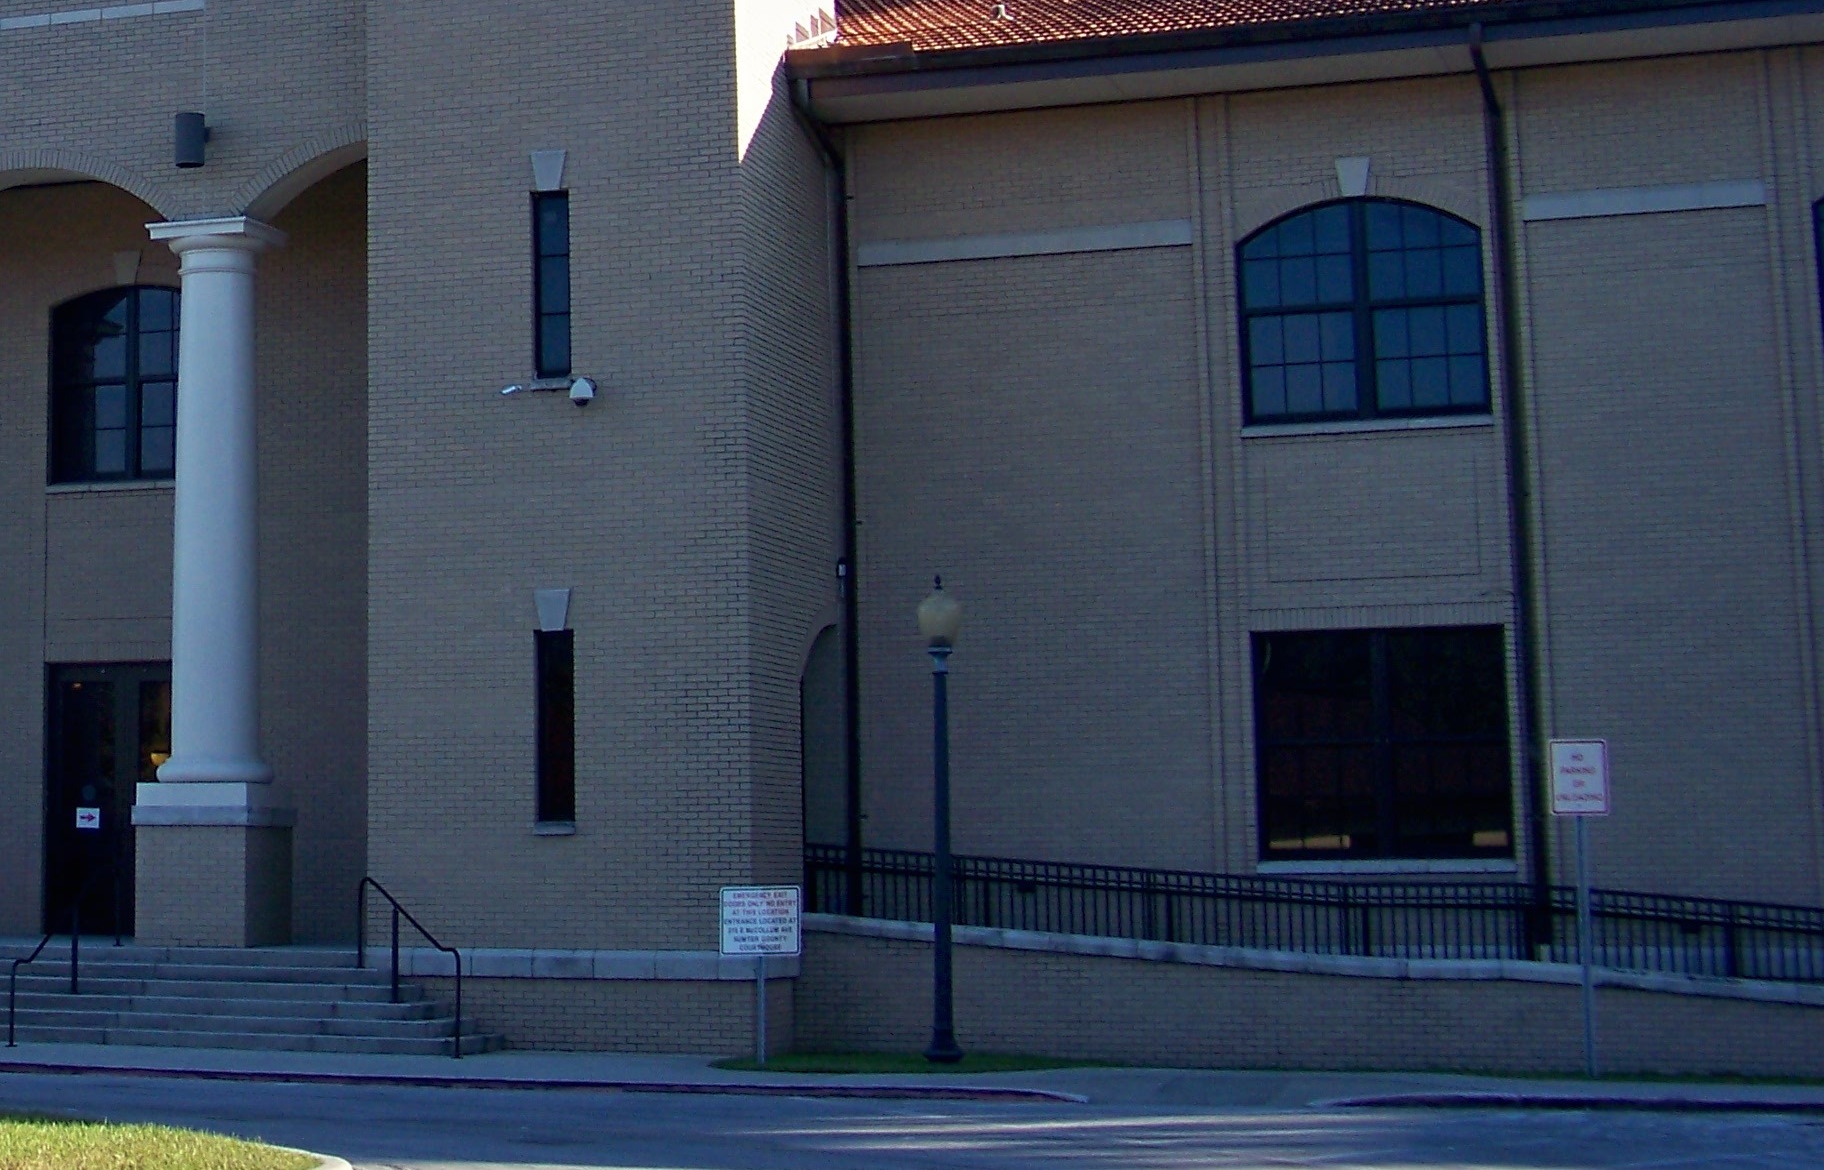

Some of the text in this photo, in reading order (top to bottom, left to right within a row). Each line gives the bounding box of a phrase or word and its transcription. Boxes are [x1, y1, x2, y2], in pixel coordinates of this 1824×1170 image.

[1571, 753, 1584, 761] NO
[1560, 766, 1596, 774] PARKING
[1573, 779, 1585, 787] OR
